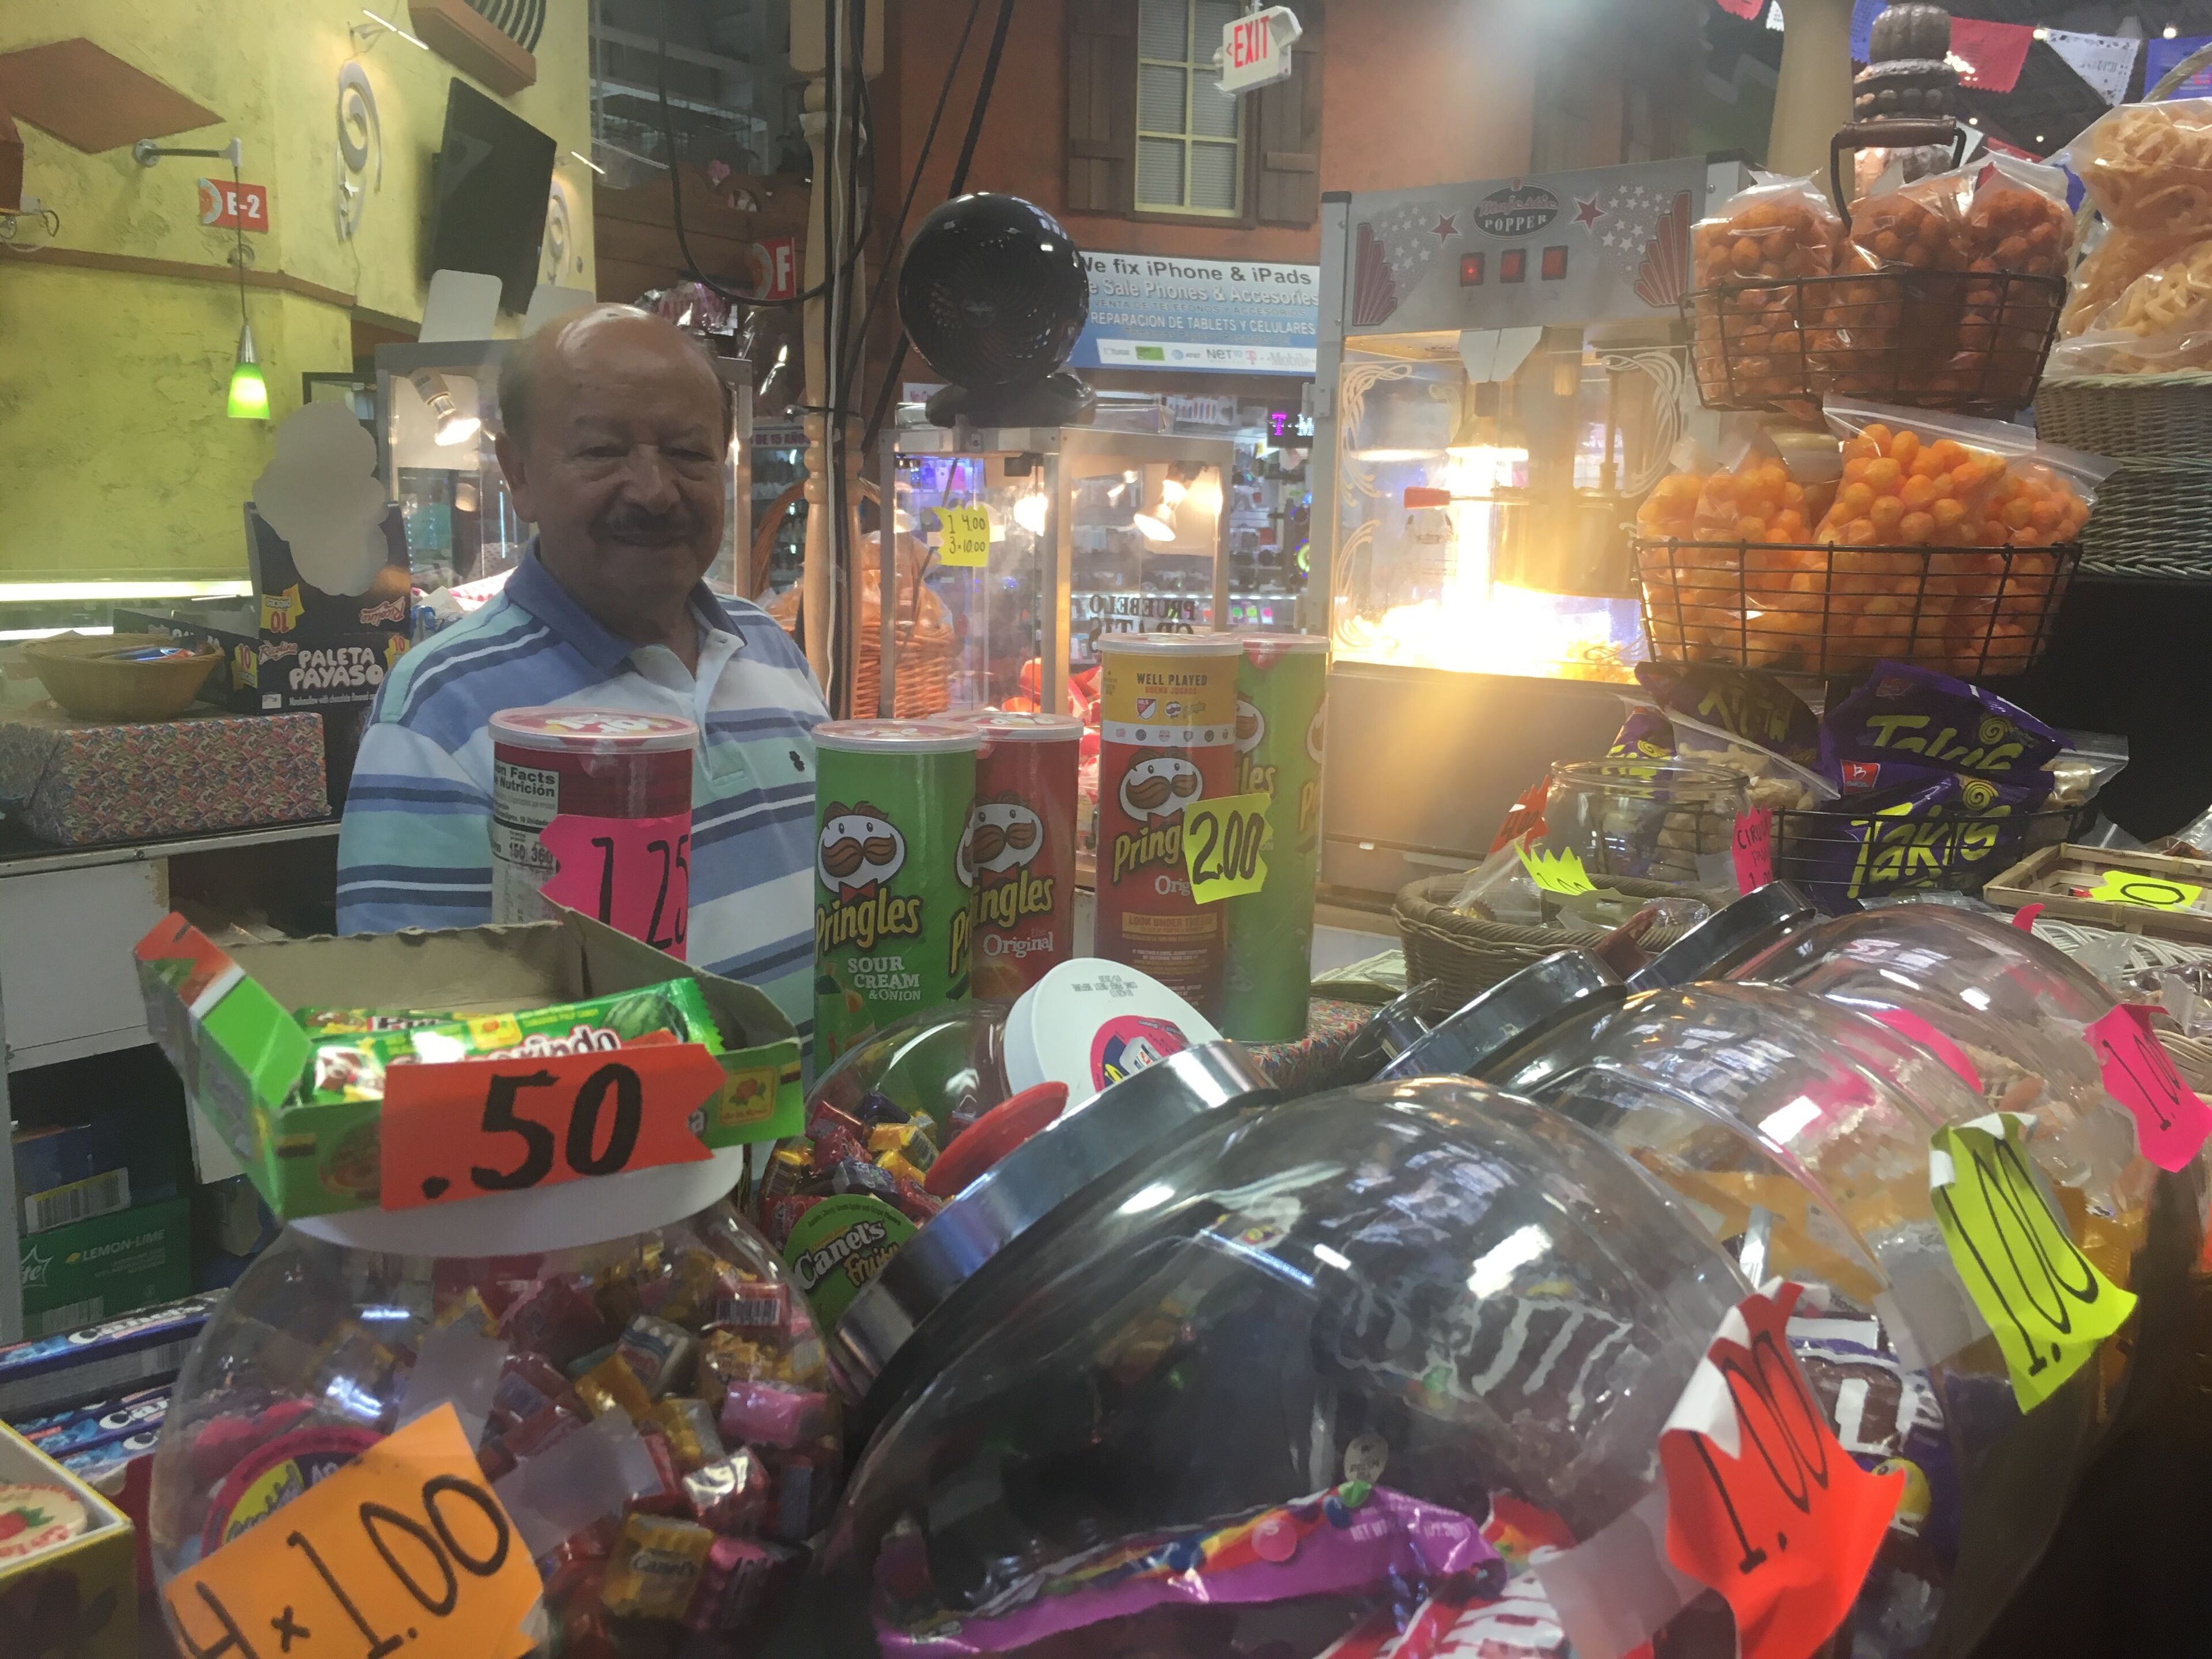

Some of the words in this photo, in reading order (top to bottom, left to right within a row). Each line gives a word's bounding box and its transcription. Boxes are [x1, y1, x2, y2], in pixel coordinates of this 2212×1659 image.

[1234, 16, 1269, 68] EXIT
[226, 191, 260, 218] E-2
[1485, 215, 1546, 232] POPPER
[1113, 259, 1141, 275] fix
[1146, 261, 1222, 281] iPhone
[1230, 266, 1247, 281] &
[1251, 267, 1312, 285] iPads
[1103, 277, 1141, 297] Sale
[1144, 280, 1209, 301] Phones
[1213, 286, 1226, 302] &
[1134, 301, 1149, 309] DE
[1153, 302, 1219, 313] TELEFONOS
[1234, 307, 1306, 317] ACCESORIOS
[1090, 312, 1165, 328] REPARACION
[1169, 316, 1184, 329] DE
[1187, 317, 1237, 332] TABLETS
[1240, 321, 1247, 331] Y
[1249, 320, 1317, 335] CELULARES
[270, 611, 290, 633] 10
[238, 643, 251, 669] 10
[392, 635, 406, 652] 10
[298, 647, 375, 669] PALETA
[289, 664, 384, 690] PAYASO
[1137, 673, 1164, 686] WELL
[1168, 674, 1207, 687] PLAYED
[500, 775, 555, 797] Nutrición
[510, 767, 555, 785] Facts
[1113, 825, 1181, 882] Pring
[1190, 810, 1265, 885] 2.00
[815, 887, 921, 965] Pringles
[983, 931, 1054, 959] Original
[848, 956, 906, 974] SOUR
[854, 974, 921, 990] CREAM
[878, 989, 921, 1001] ONION
[421, 1062, 643, 1200] .50
[82, 1229, 166, 1262] LEMON-LIME
[794, 1222, 886, 1290] Canel's
[1939, 1138, 2100, 1377] 1.00
[1690, 1329, 1830, 1575] 1.00
